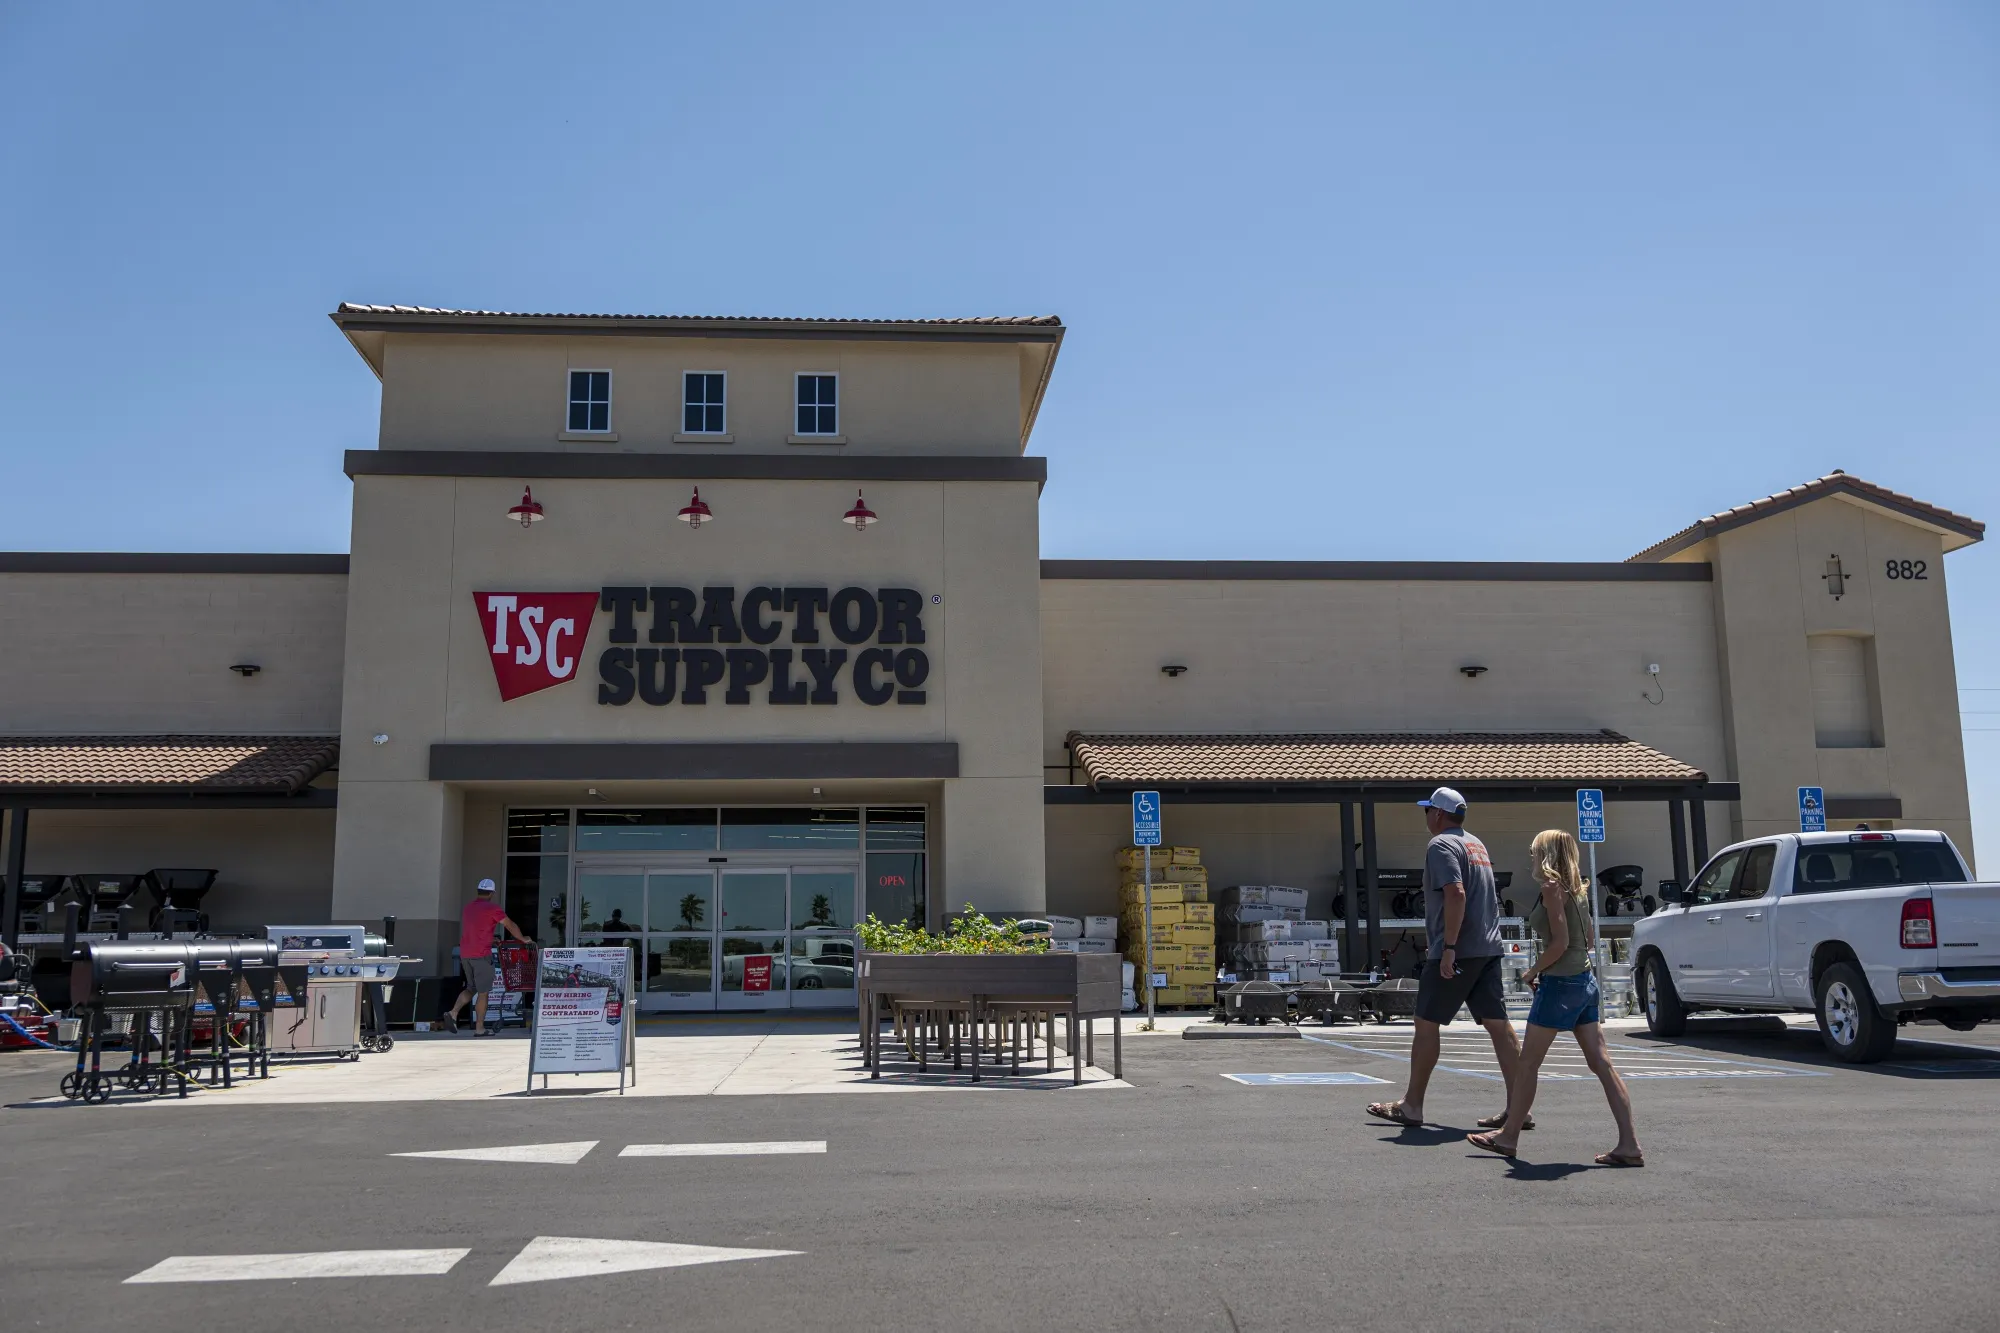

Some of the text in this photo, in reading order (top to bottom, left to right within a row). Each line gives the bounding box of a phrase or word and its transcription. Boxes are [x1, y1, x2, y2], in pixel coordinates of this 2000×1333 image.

[1886, 559, 1928, 581] 882
[600, 586, 927, 645] TRACTOR
[487, 595, 575, 679] TSC
[598, 647, 848, 706] SUPPLY
[1579, 810, 1602, 818] PARKING
[1801, 807, 1823, 816] PARKING
[1583, 818, 1598, 826] ONLY
[1805, 815, 1820, 824] ONLY
[1135, 821, 1159, 829] ACCESSIBLE
[879, 875, 905, 887] OPEN
